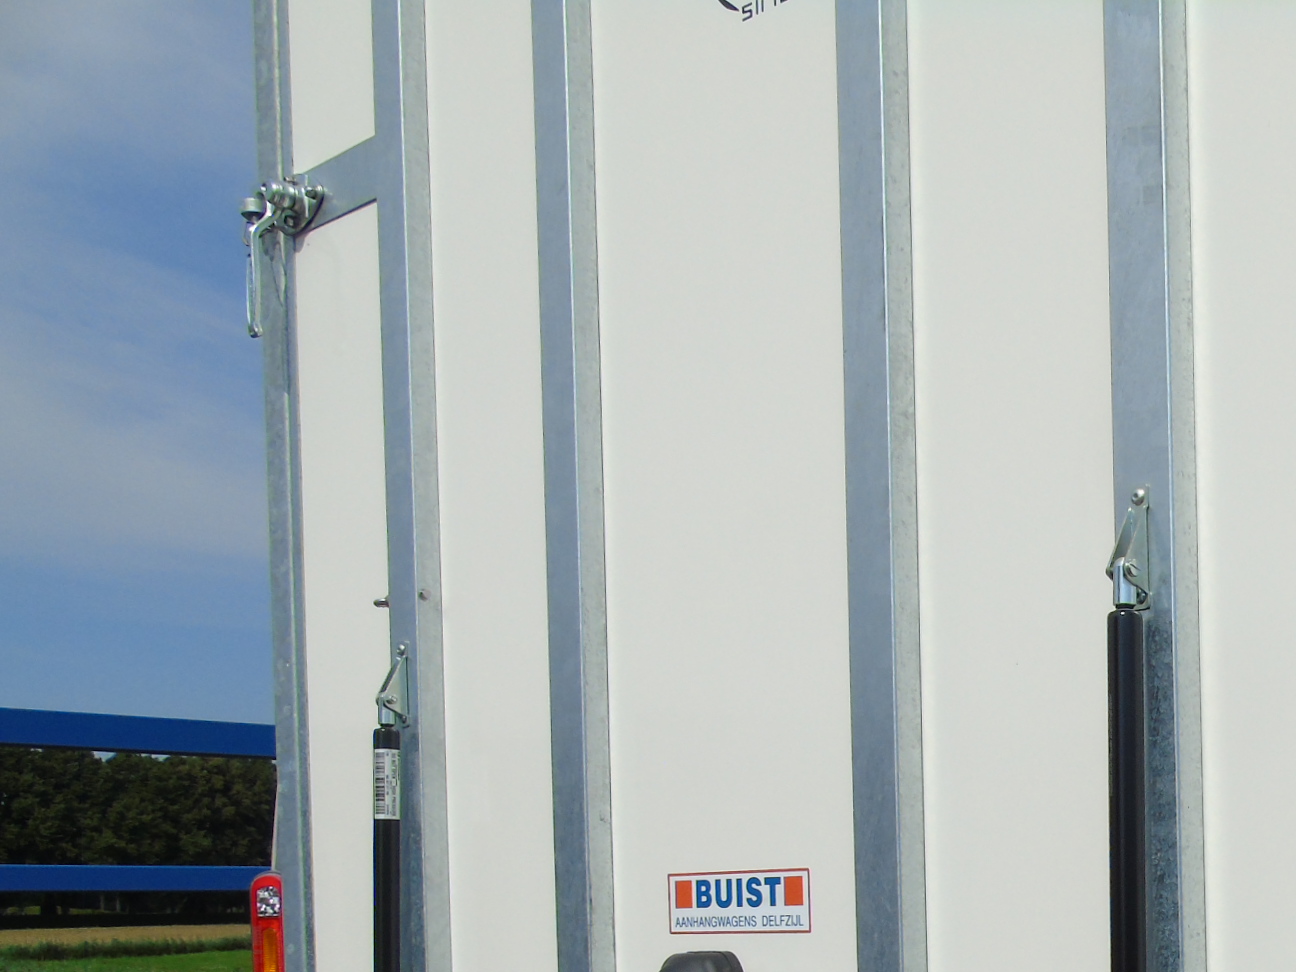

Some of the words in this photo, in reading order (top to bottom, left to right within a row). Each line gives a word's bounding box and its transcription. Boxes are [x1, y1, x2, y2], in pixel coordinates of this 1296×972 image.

[695, 876, 782, 908] BUIST
[675, 915, 757, 928] AANHANGWAGENS
[761, 914, 804, 927] DELFZIJL
